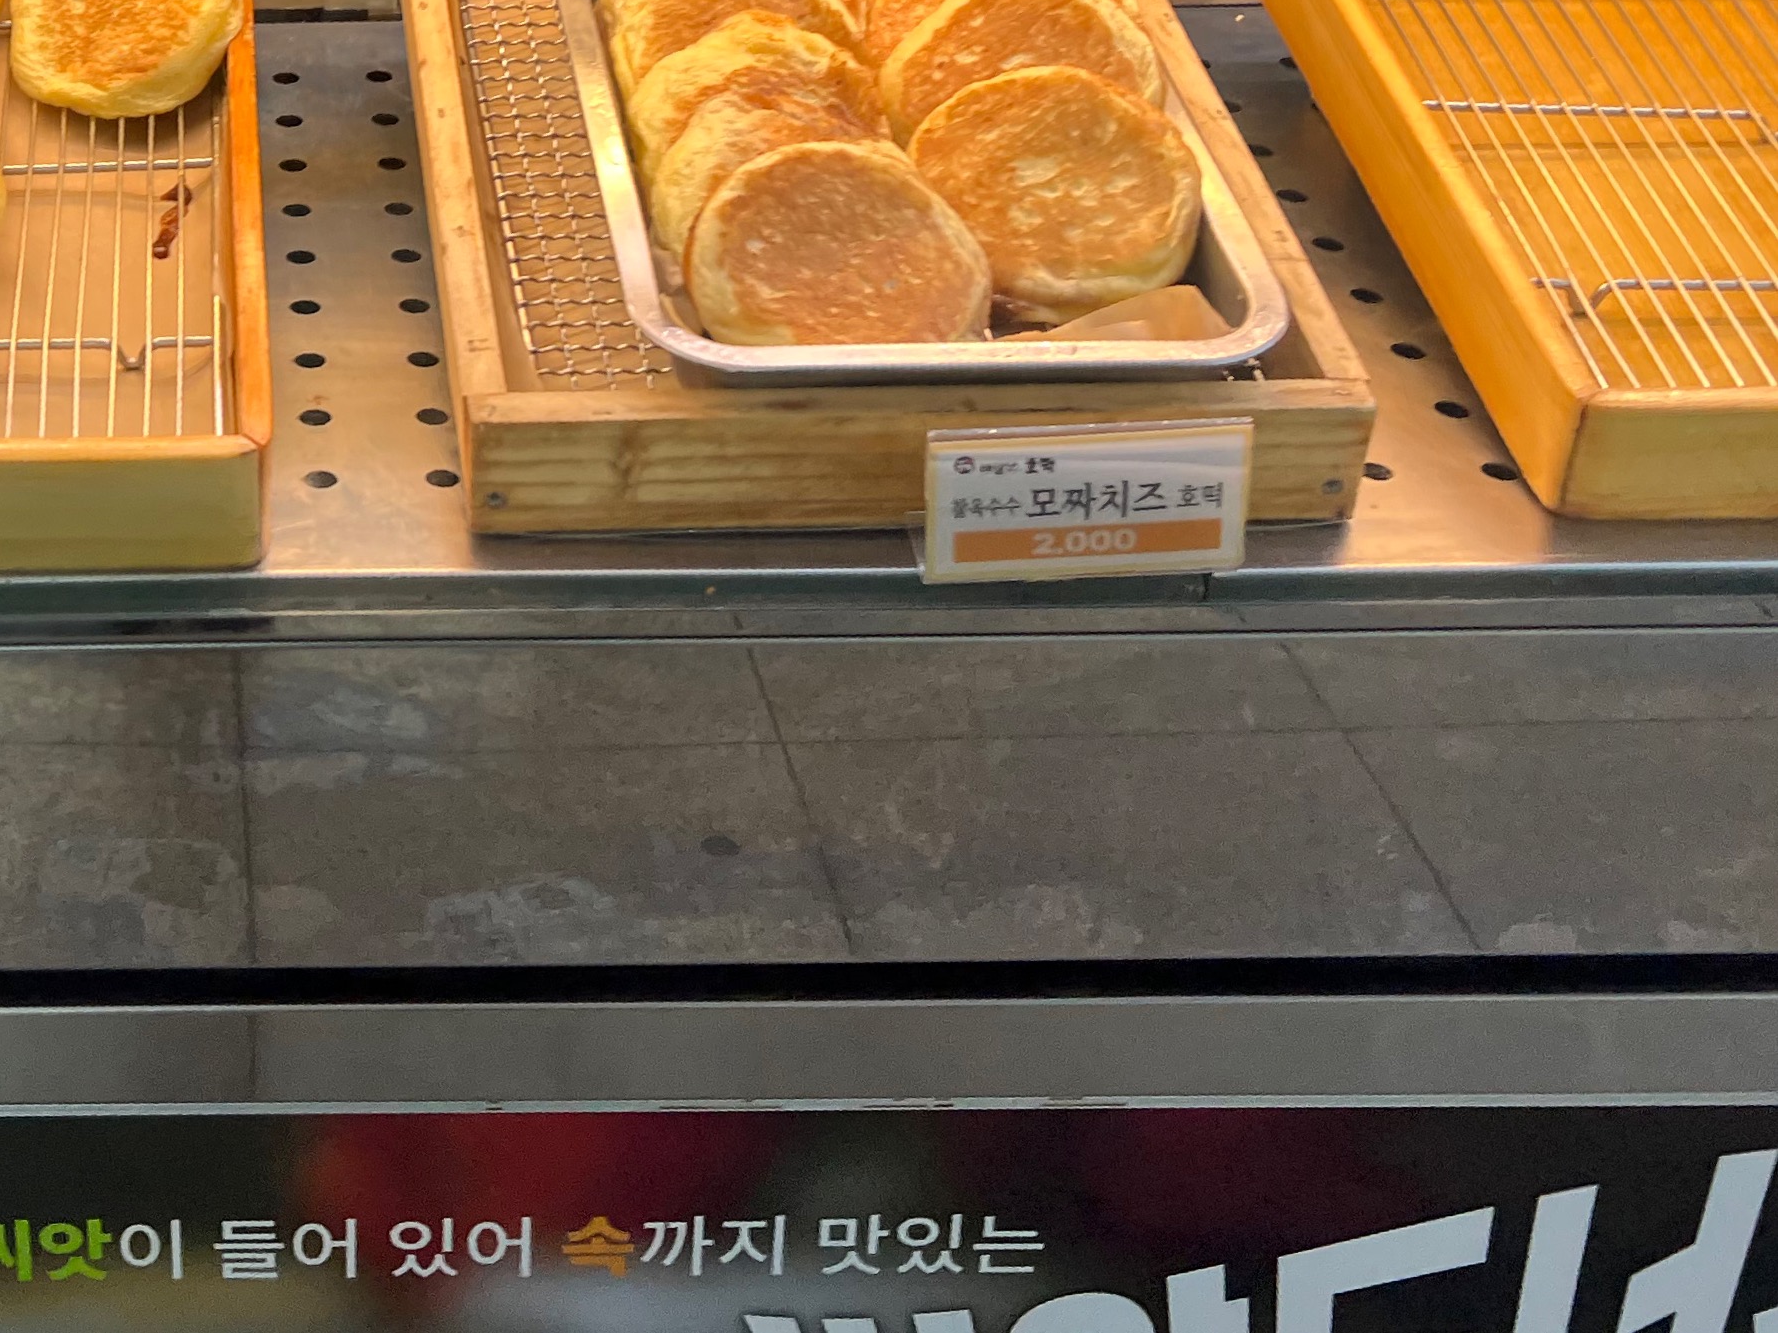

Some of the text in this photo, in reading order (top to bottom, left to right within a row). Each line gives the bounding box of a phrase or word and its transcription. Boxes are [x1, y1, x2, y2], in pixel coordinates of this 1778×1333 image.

[1026, 480, 1168, 520] 모짜치즈
[1176, 482, 1223, 508] 호떡
[214, 1218, 357, 1279] 들어
[389, 1216, 532, 1279] 있어
[562, 1214, 787, 1277] 속까지
[818, 1213, 1045, 1275] 맛있는
